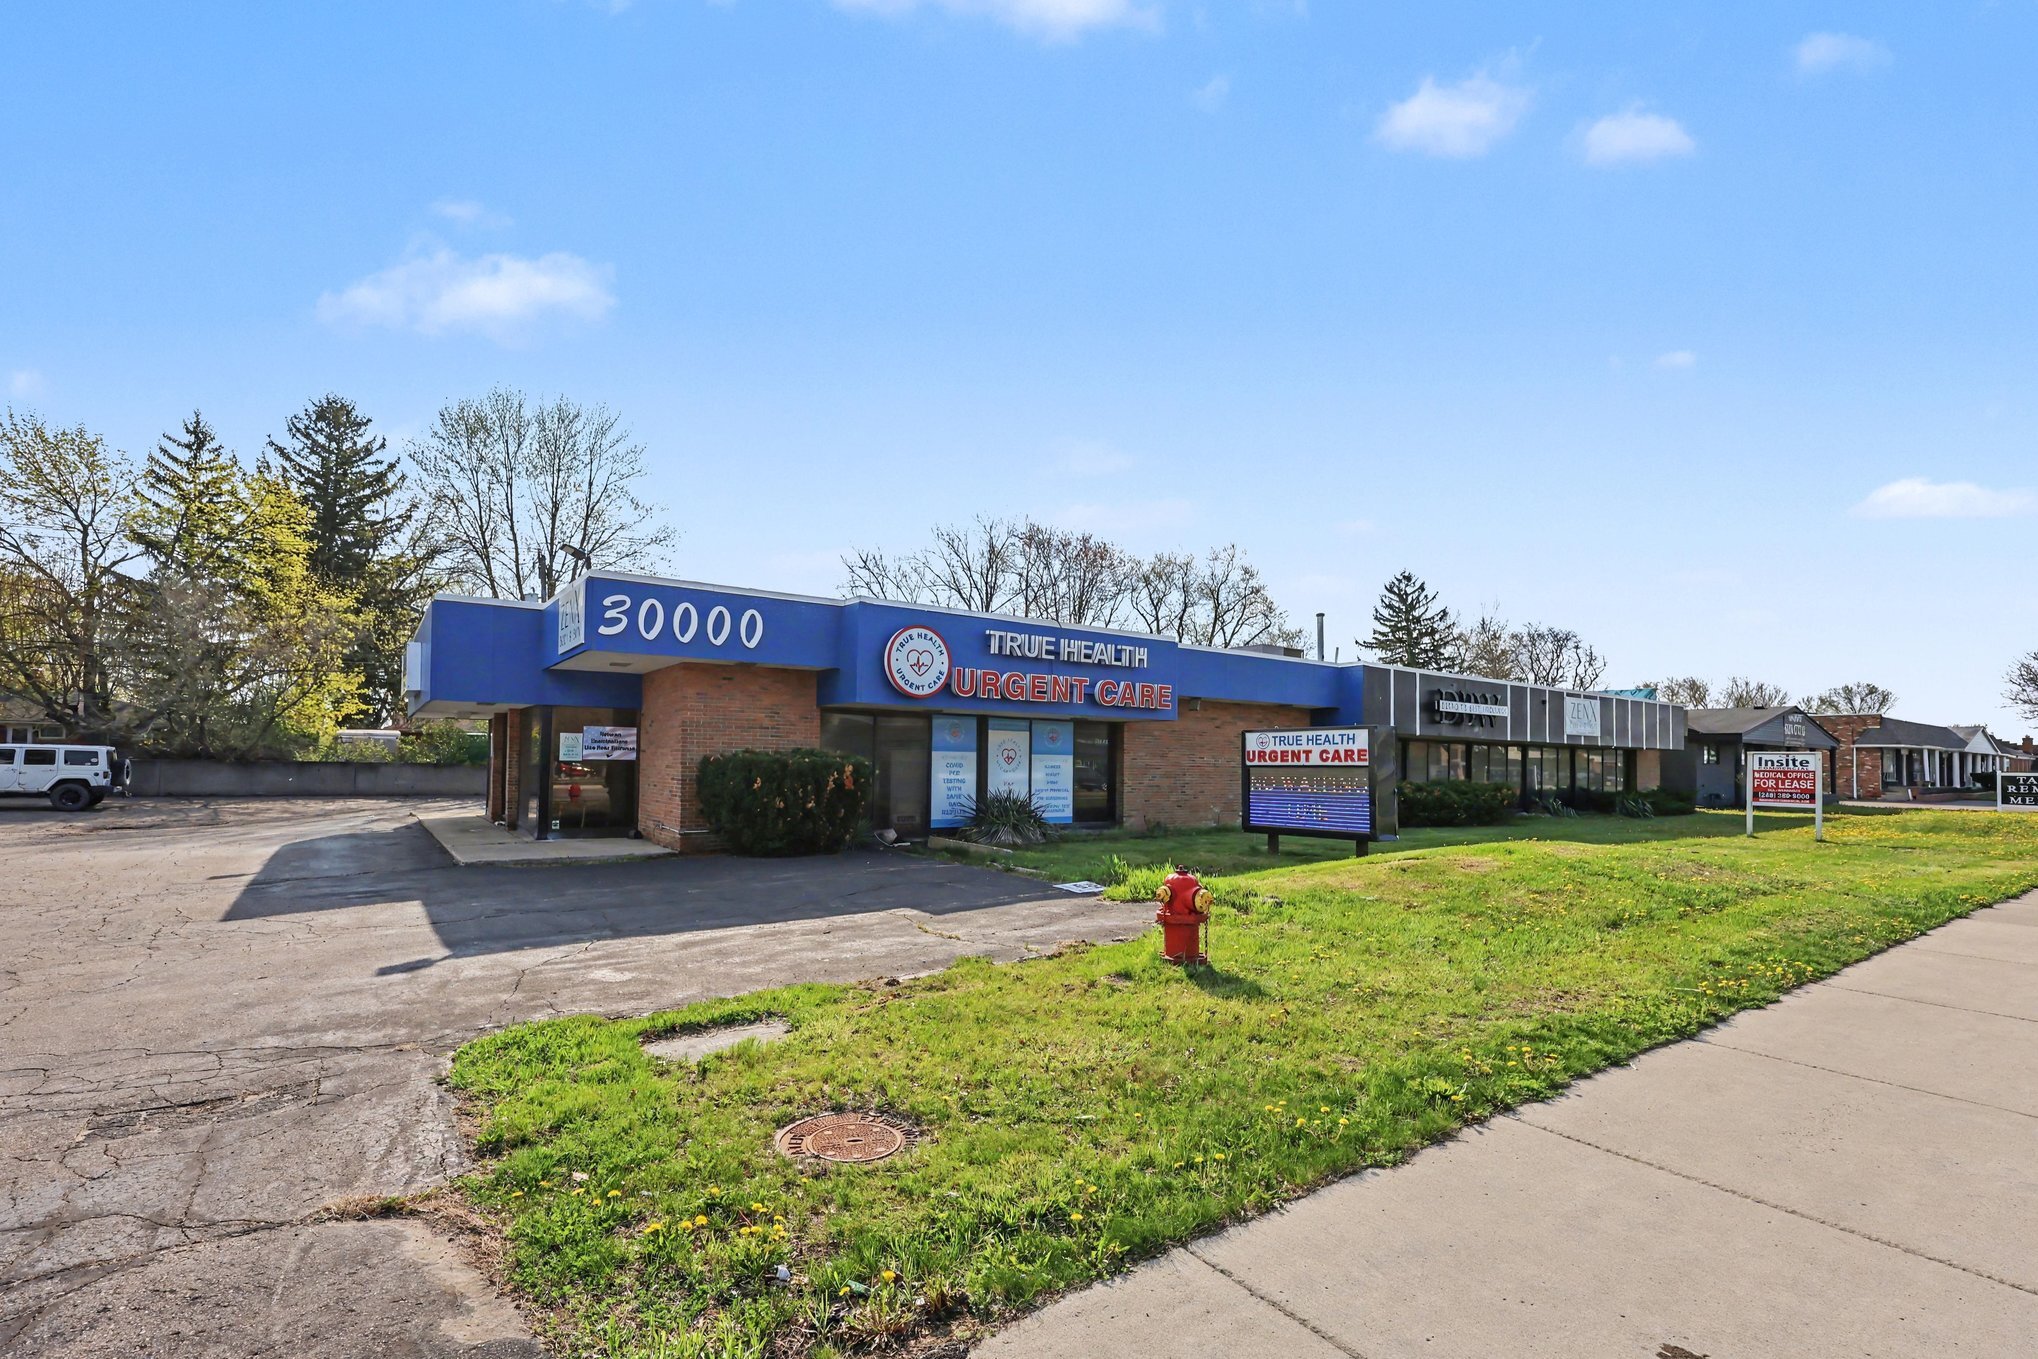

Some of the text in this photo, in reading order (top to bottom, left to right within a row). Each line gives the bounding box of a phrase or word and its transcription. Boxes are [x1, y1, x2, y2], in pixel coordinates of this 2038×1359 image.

[598, 595, 763, 648] 30000
[896, 632, 944, 656] TRUE HEALTH
[985, 630, 1147, 668] TRUE HEALTH
[897, 668, 945, 691] URGENT CARE
[953, 667, 1172, 709] URGENT CARE
[1272, 733, 1355, 746] TRUE HEALTH
[1247, 749, 1367, 762] URGENT CARE
[1758, 754, 1810, 767] Insite
[1754, 779, 1814, 789] FOR LEASE
